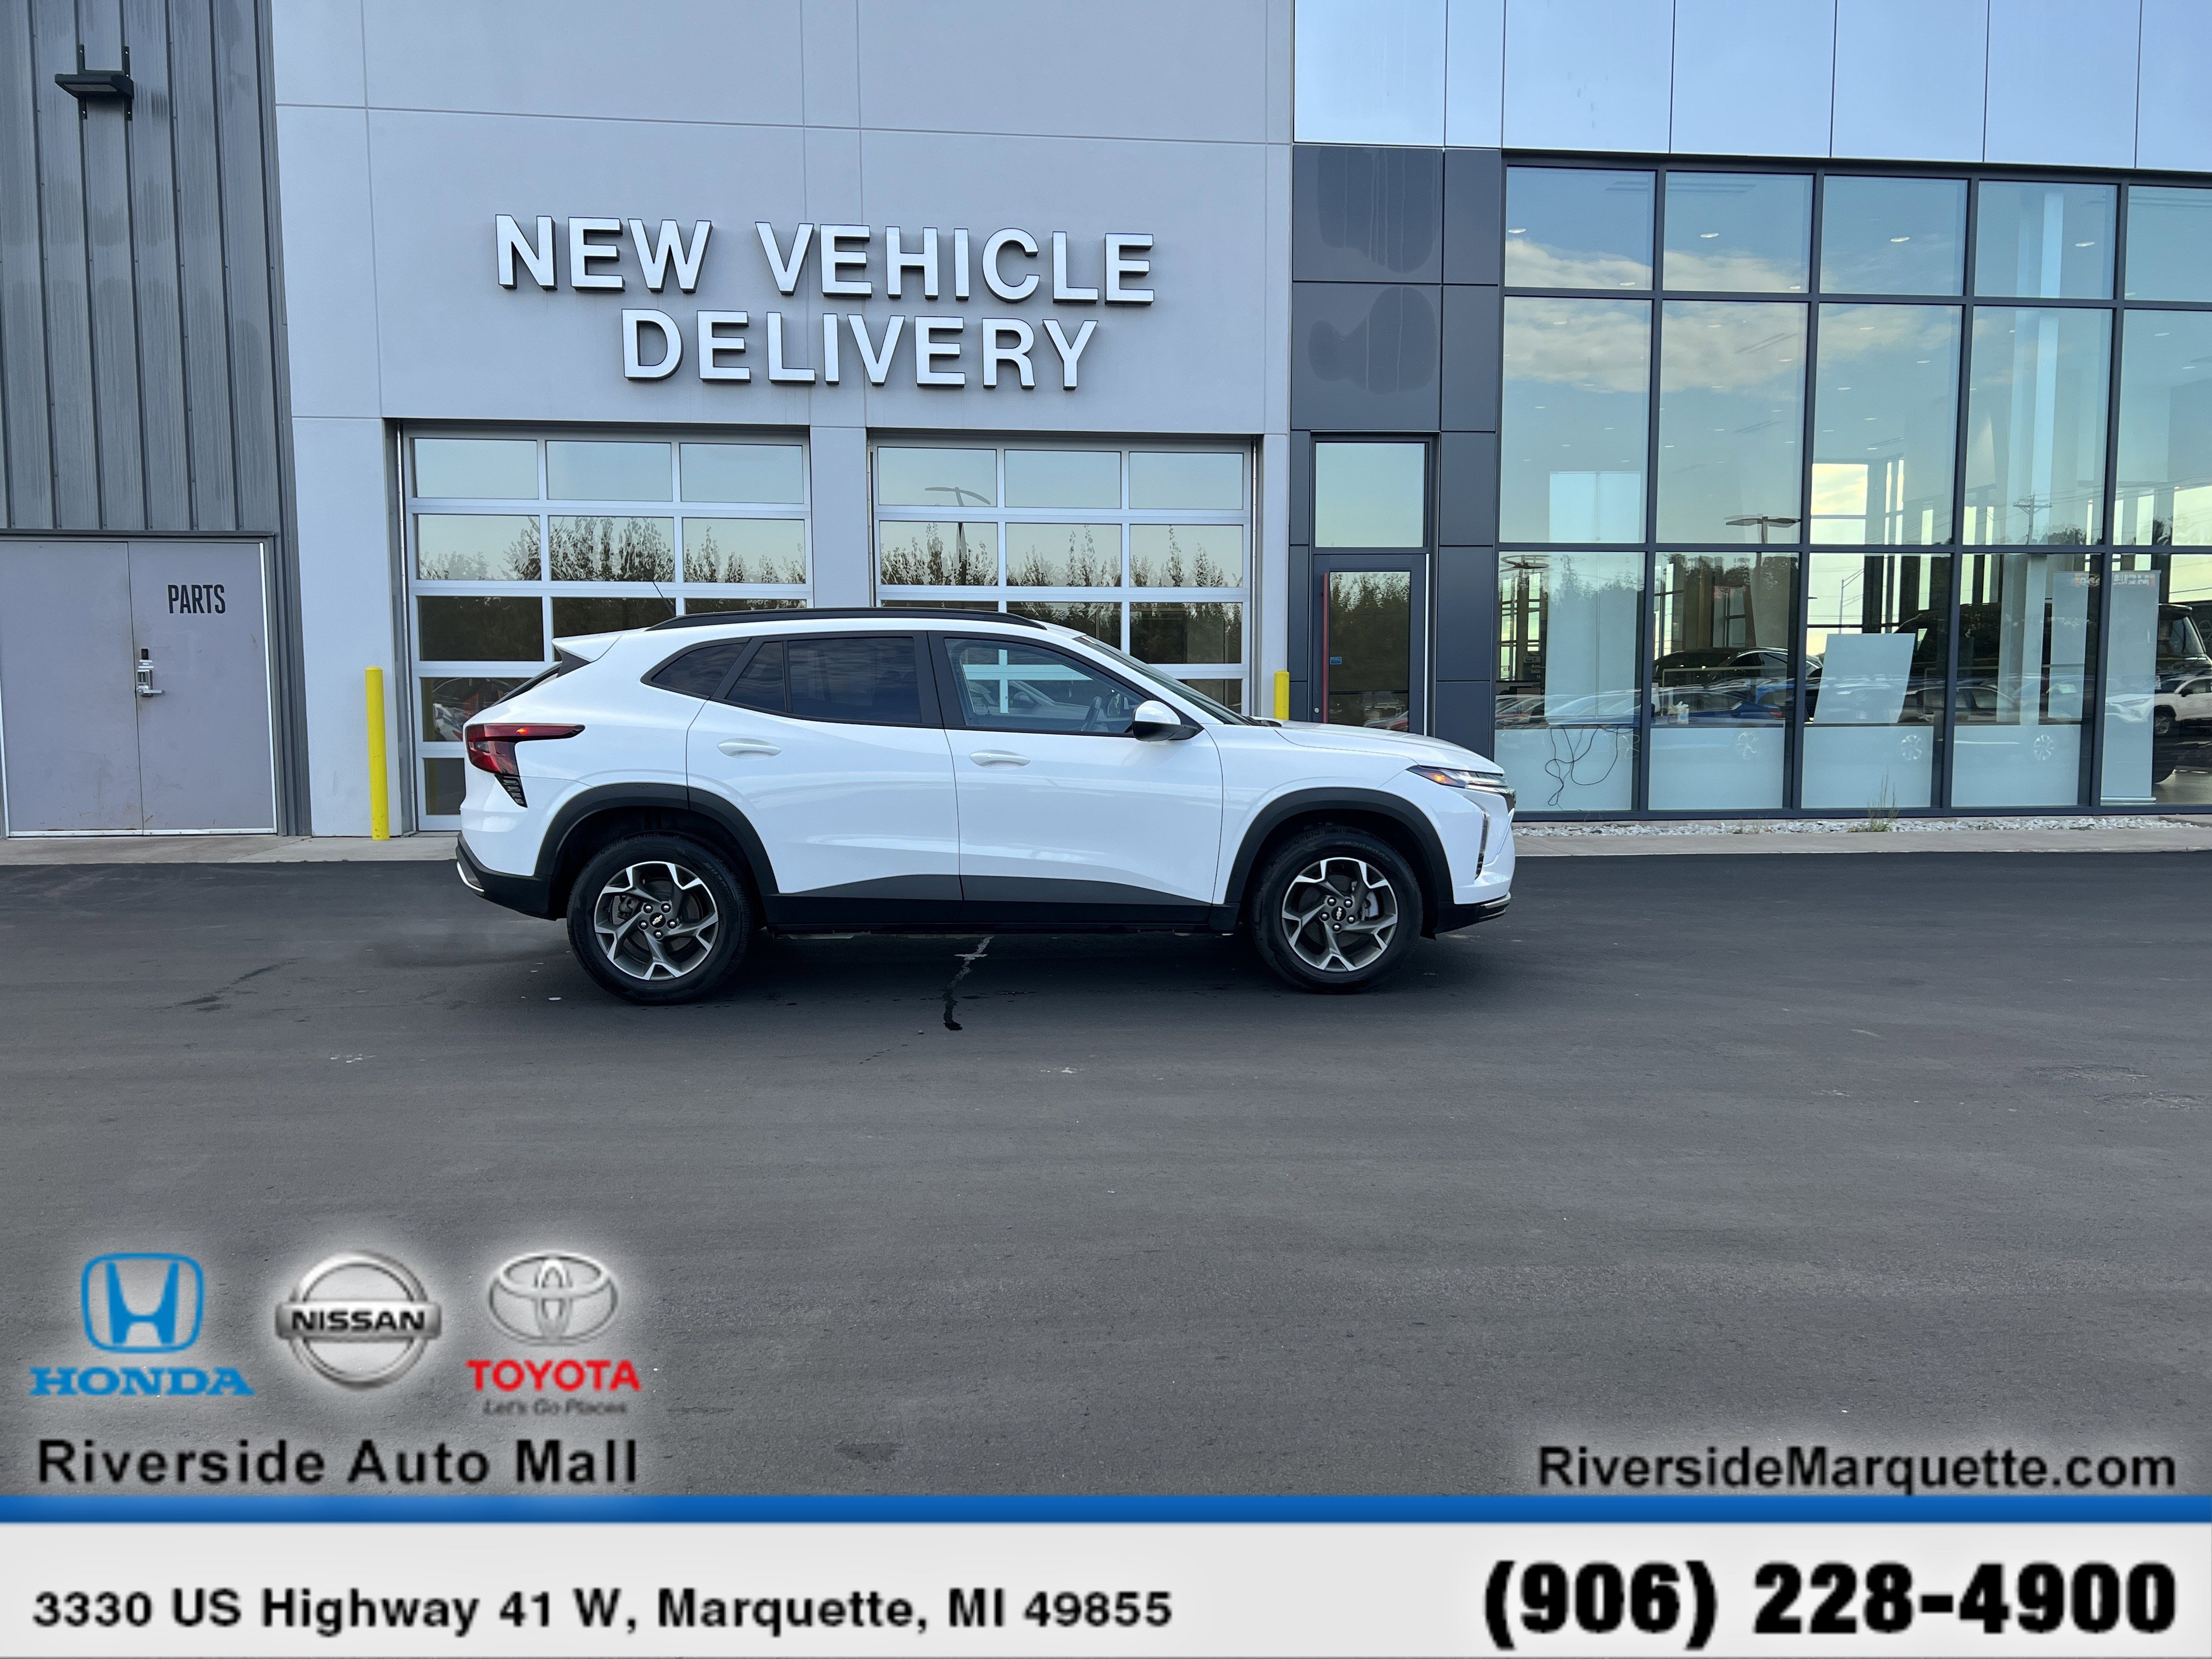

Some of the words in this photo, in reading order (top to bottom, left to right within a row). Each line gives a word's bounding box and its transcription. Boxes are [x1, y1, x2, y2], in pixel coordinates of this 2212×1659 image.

[495, 214, 712, 294] NEW
[754, 221, 1155, 306] VEHICLE
[621, 308, 1098, 391] DELIVERY
[167, 584, 226, 614] PARTS
